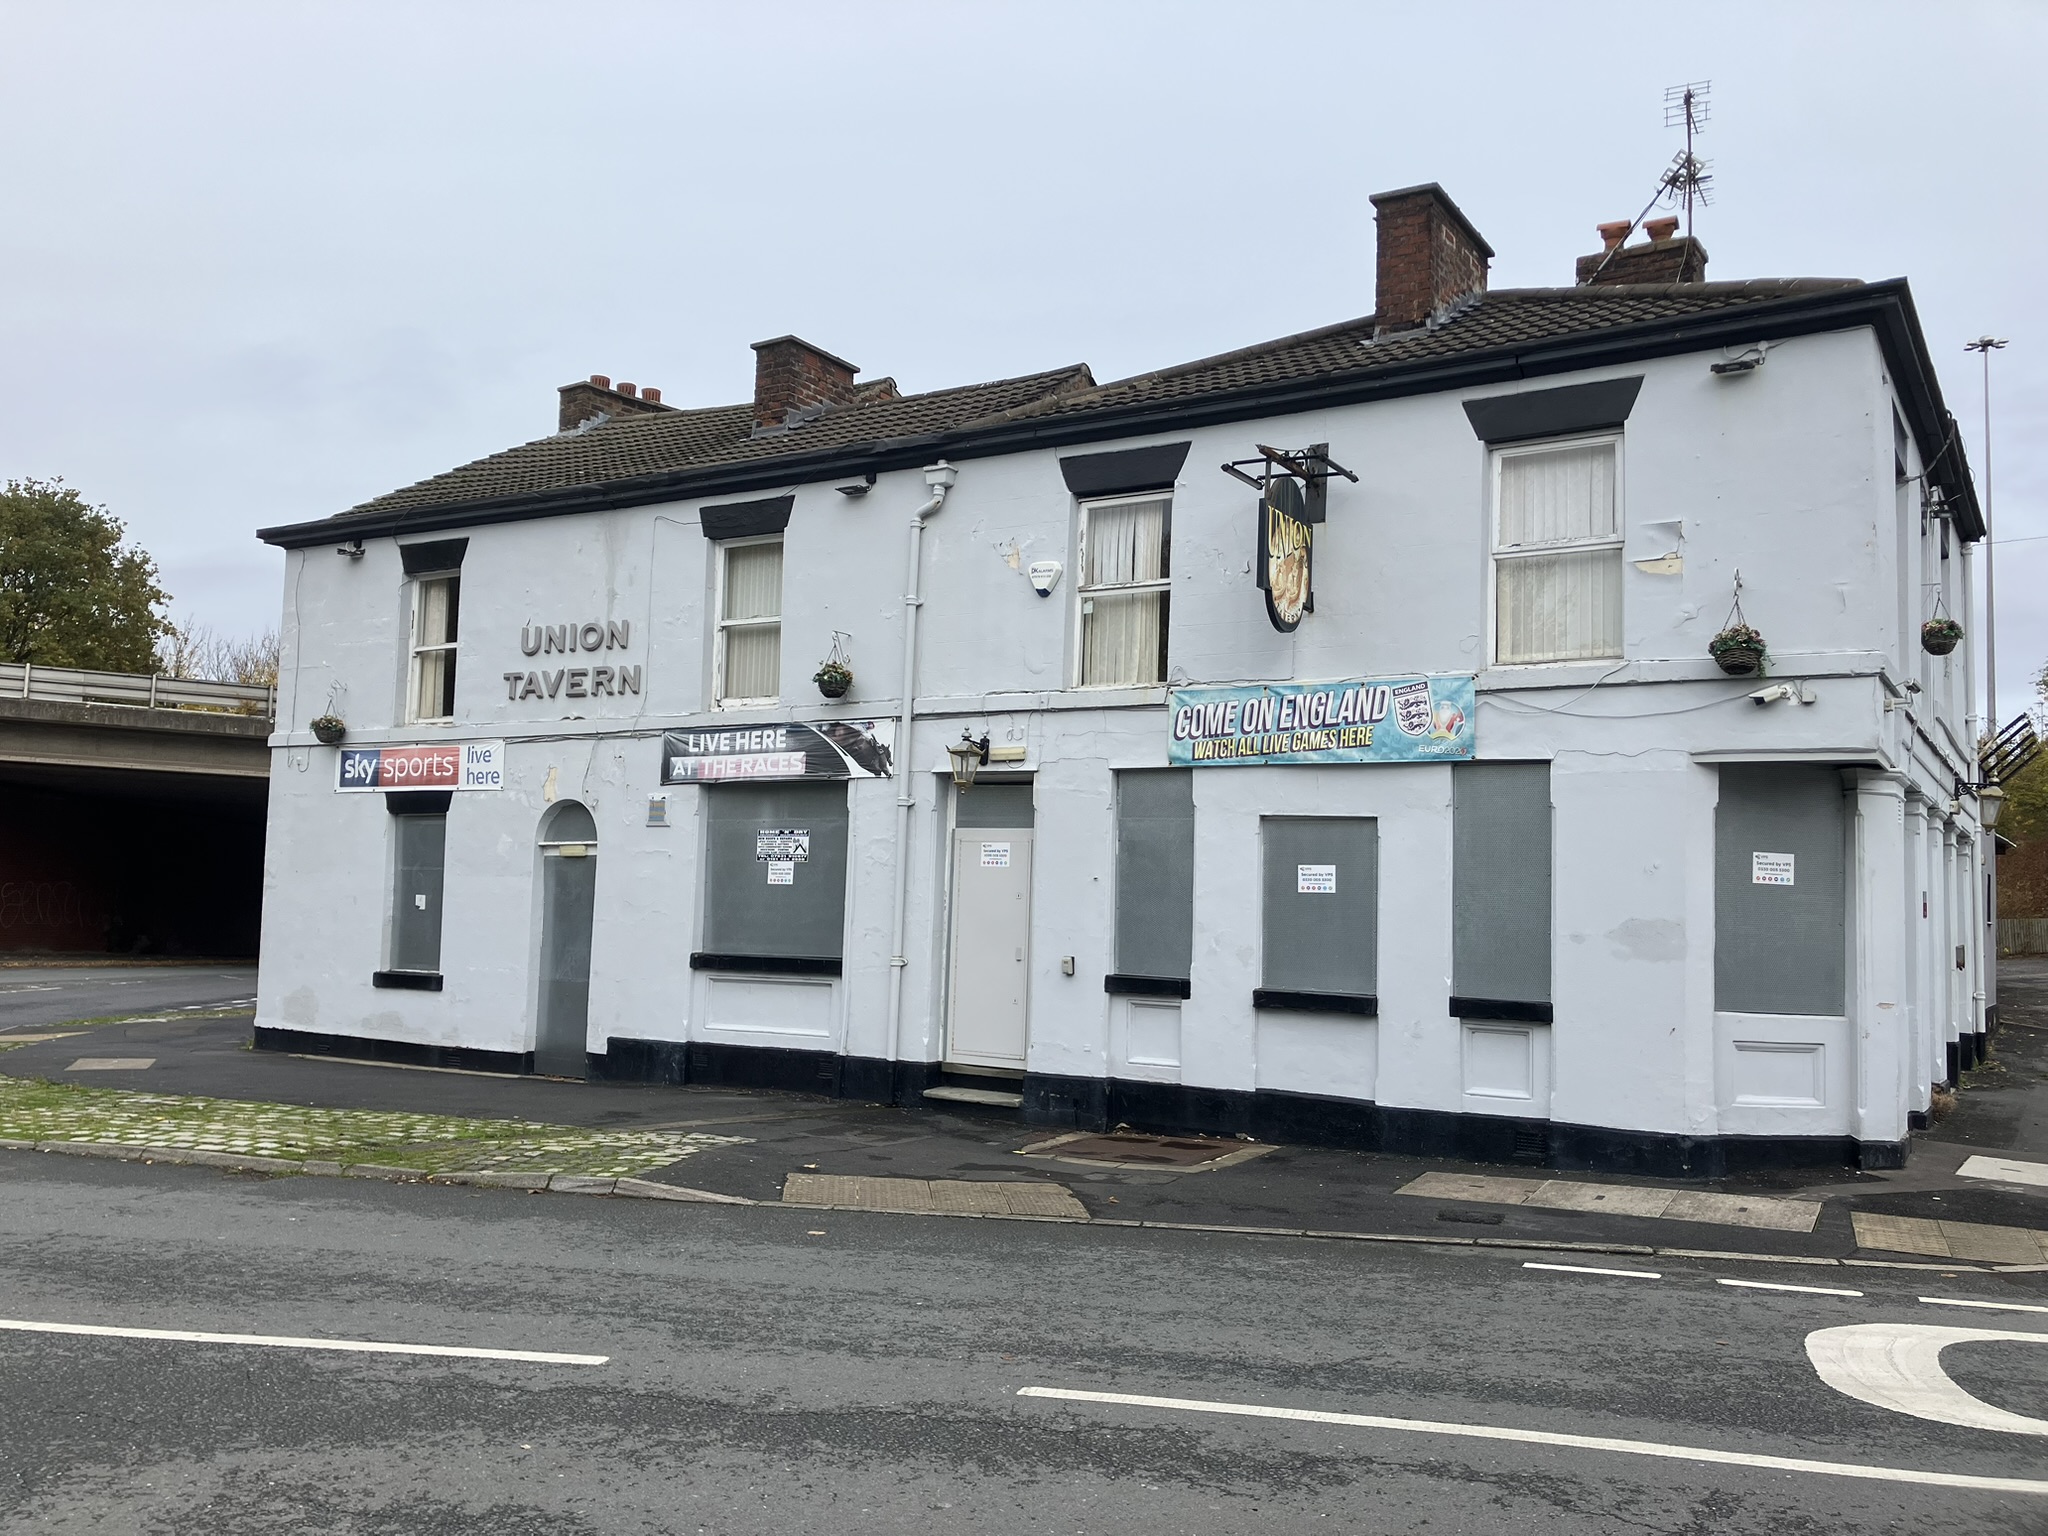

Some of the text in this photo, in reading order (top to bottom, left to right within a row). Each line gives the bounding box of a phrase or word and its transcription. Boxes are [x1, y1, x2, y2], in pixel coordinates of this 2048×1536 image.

[1267, 505, 1312, 558] UNION
[521, 619, 630, 656] UNION
[503, 665, 641, 700] TAVERN
[1394, 684, 1426, 695] ENGLAND
[1173, 685, 1391, 741] COME ON ENGLAND
[466, 745, 492, 764] live
[688, 729, 787, 752] LIVE HERE
[1192, 725, 1375, 761] WATCH ALL LIVE GAMES HERE
[344, 753, 454, 784] sky sports
[466, 768, 500, 785] here
[672, 756, 802, 776] AT THE RACES
